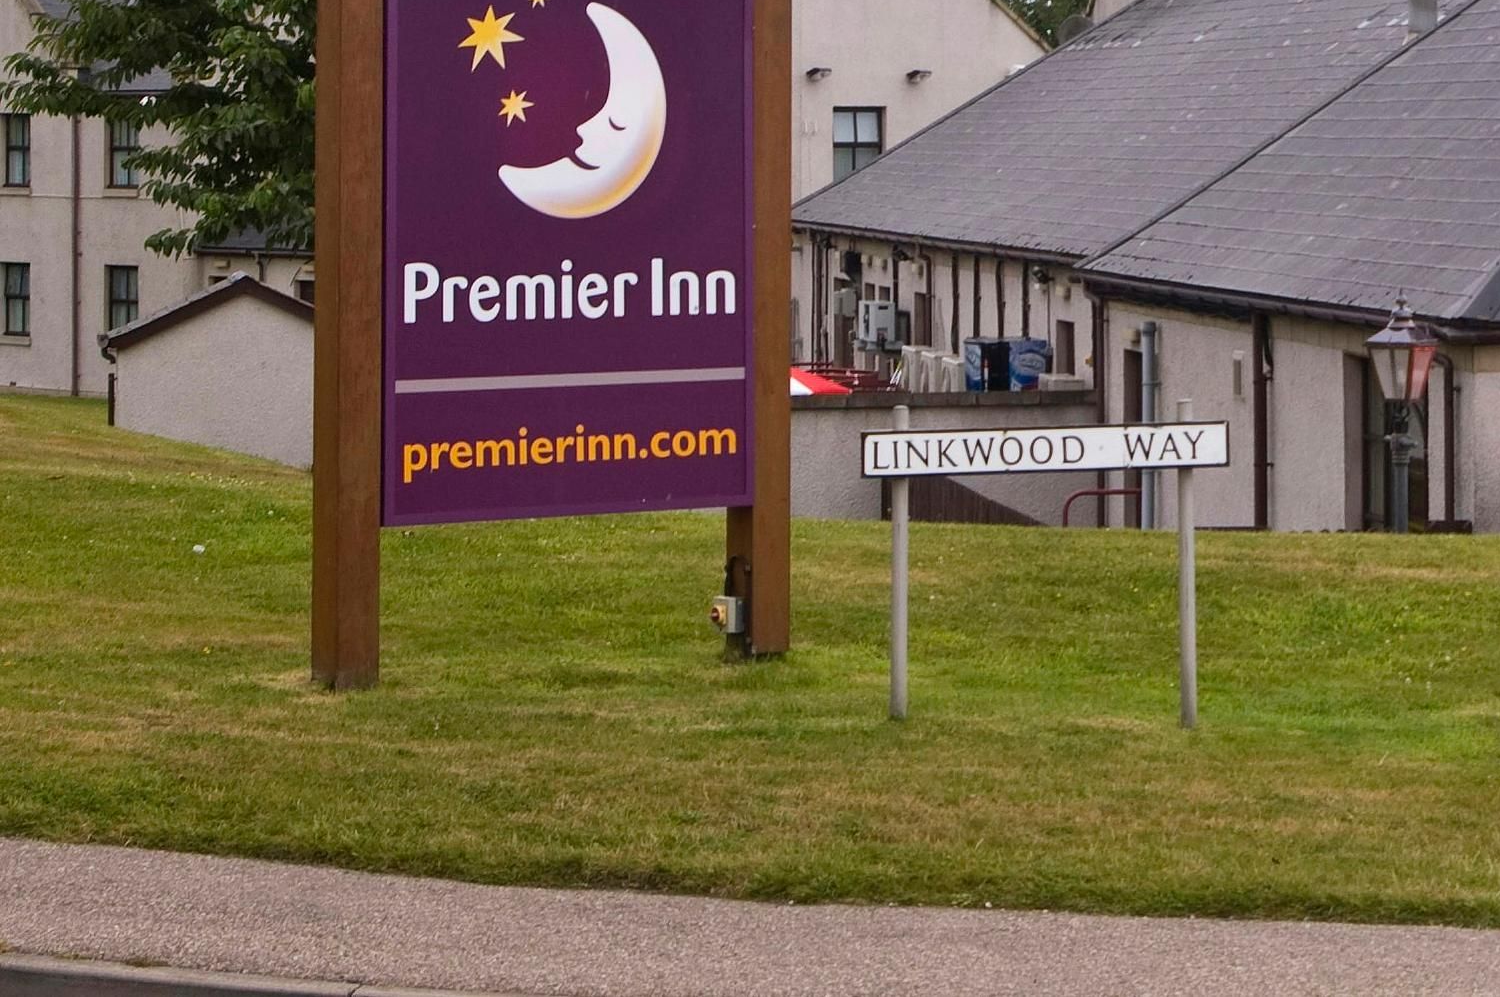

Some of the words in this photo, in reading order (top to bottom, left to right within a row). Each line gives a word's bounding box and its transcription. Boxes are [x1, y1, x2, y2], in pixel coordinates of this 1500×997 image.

[403, 258, 638, 324] Premier
[650, 257, 737, 317] Inn
[402, 424, 738, 484] premierinn.com
[872, 434, 1086, 470] LINKWOOD
[1123, 430, 1206, 462] WAY
